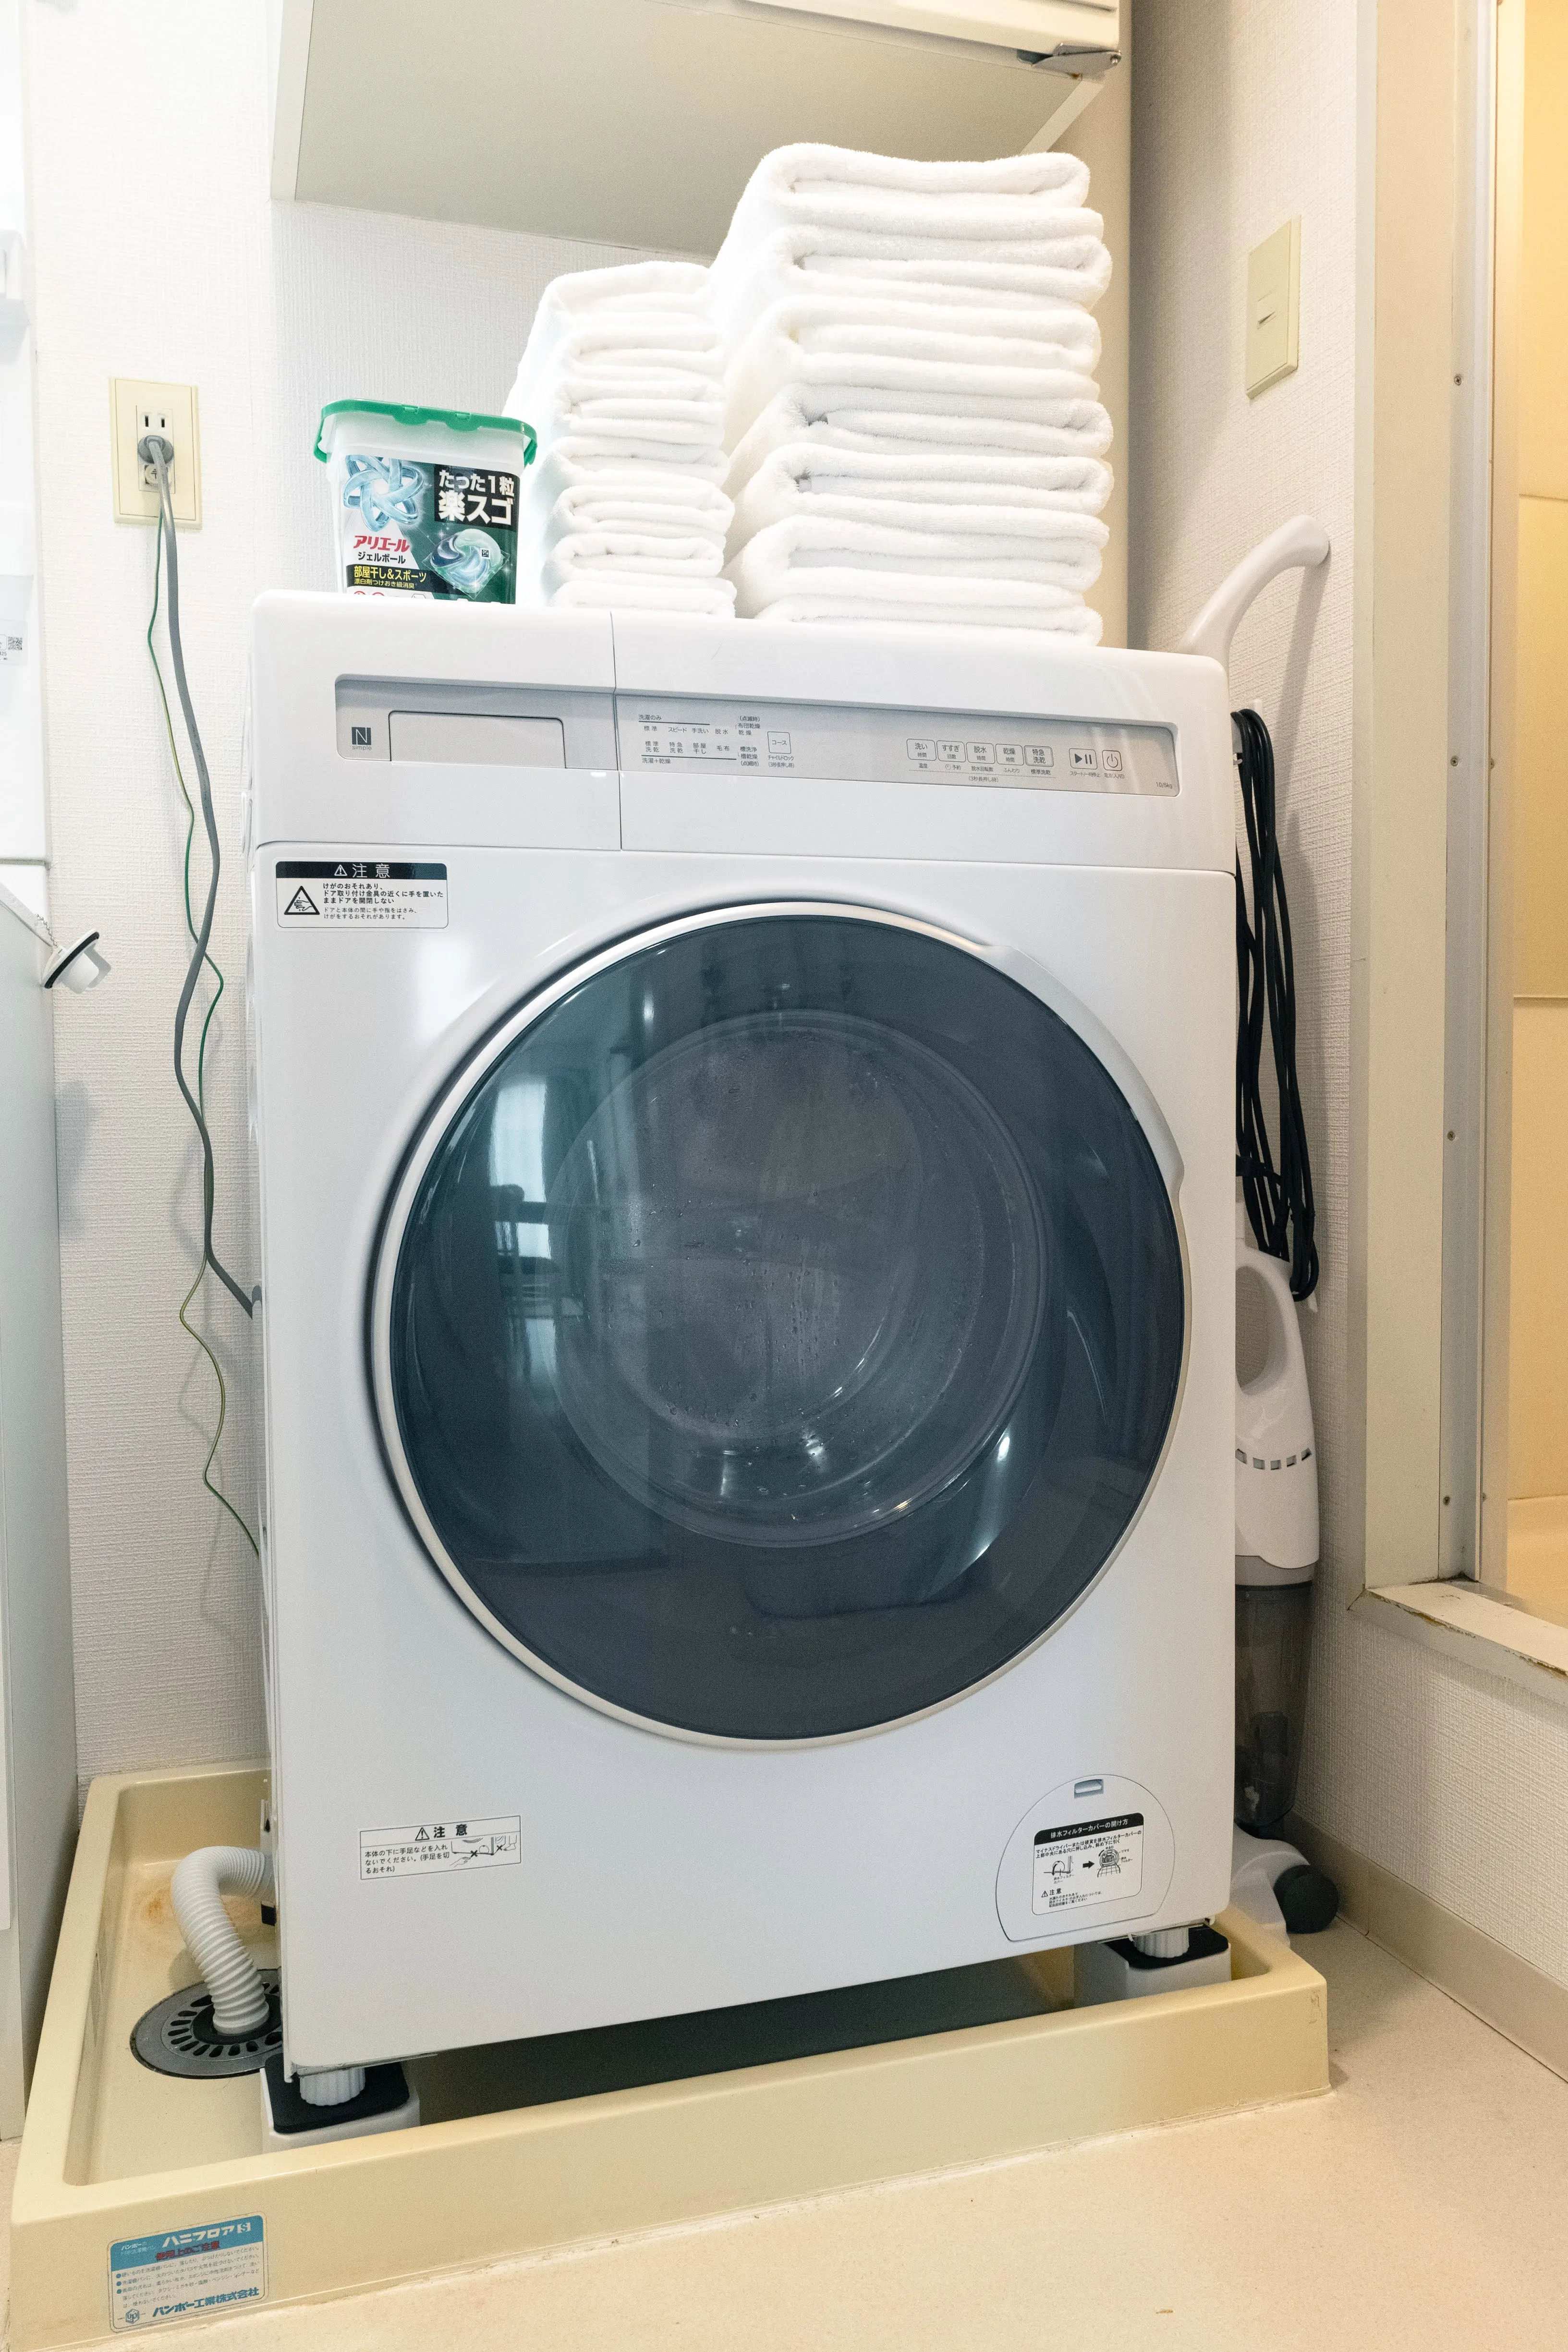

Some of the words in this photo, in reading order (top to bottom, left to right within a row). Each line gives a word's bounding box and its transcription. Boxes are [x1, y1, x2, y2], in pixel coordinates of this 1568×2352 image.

[439, 469, 514, 497] たった1粒
[438, 490, 512, 526] 楽スゴ
[353, 535, 410, 552] アリエール
[358, 552, 405, 564] ジェルボール
[354, 566, 426, 582] 部屋干し&スポーツ
[1051, 1819, 1128, 1839] 排水フィルターカバーの開け方
[365, 1844, 448, 1857] 本体の下に手足などを入れ
